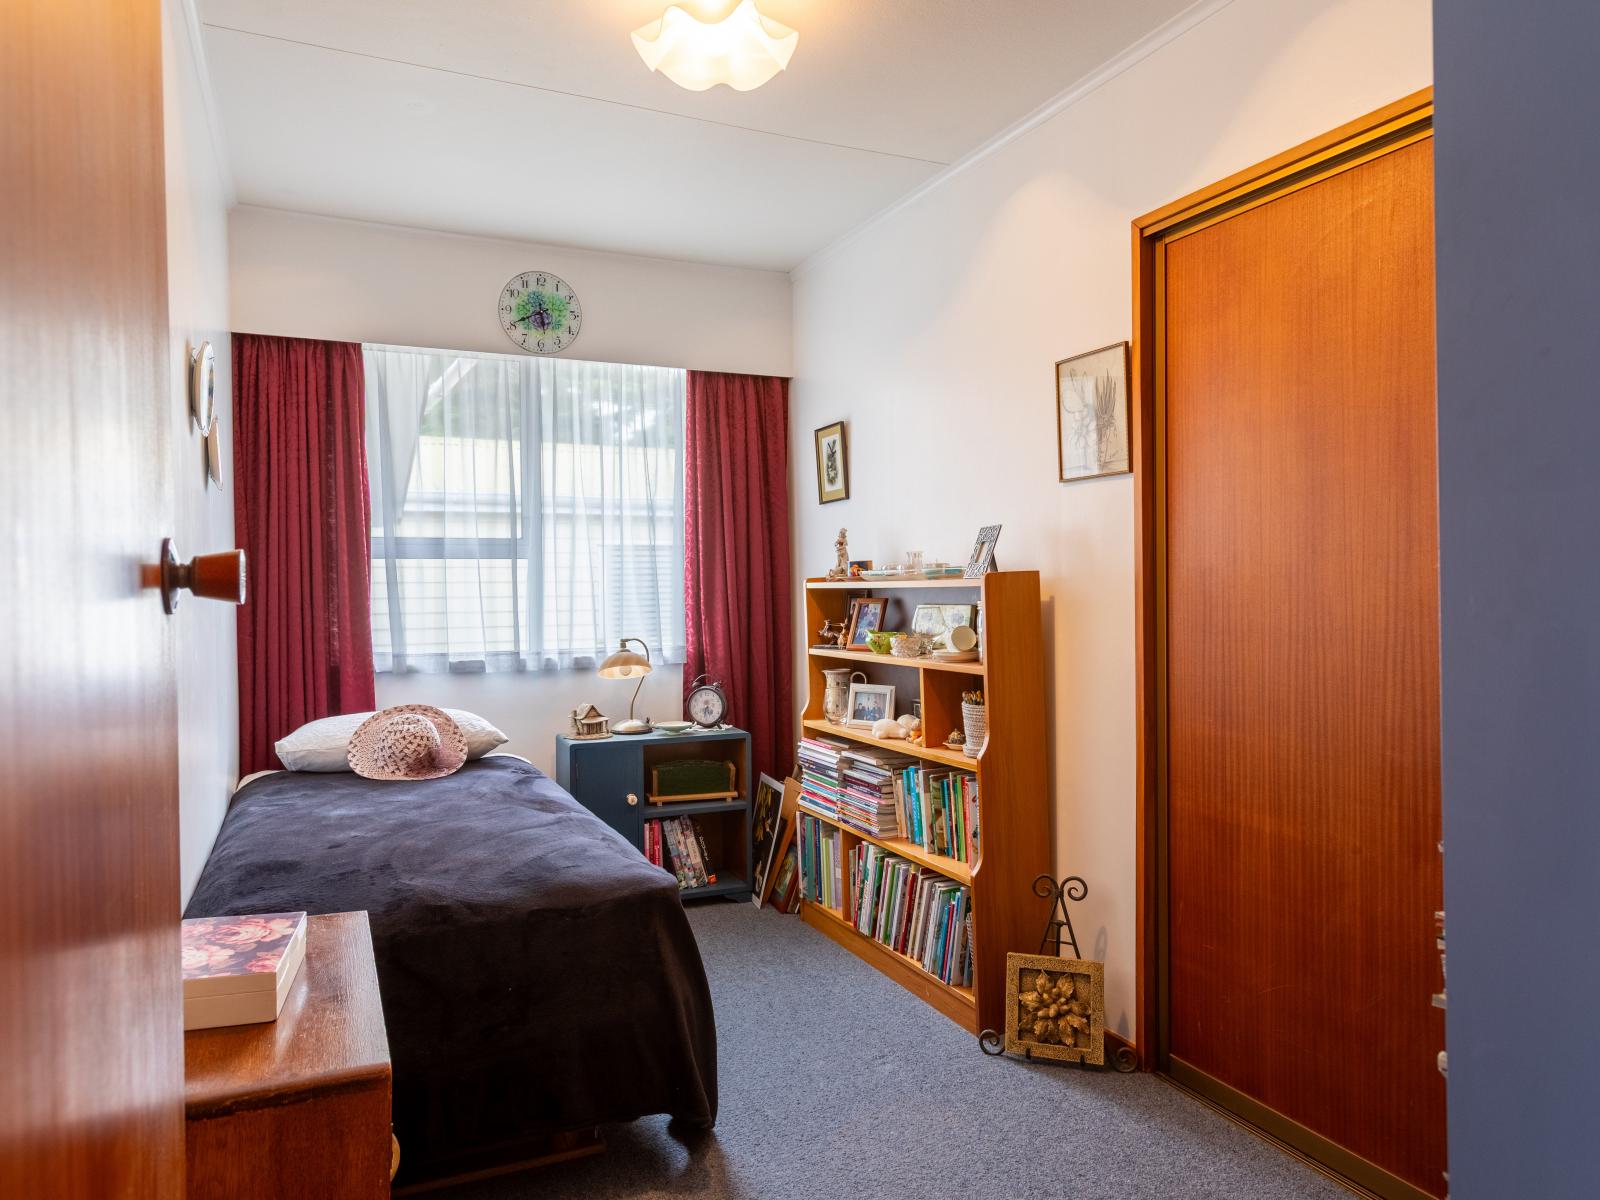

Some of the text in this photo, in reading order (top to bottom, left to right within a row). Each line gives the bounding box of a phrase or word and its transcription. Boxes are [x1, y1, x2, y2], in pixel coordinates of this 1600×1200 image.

[522, 279, 529, 288] 11
[536, 277, 546, 286] 12
[555, 283, 559, 292] 1
[510, 288, 520, 298] 10
[505, 305, 512, 314] 9
[510, 321, 517, 330] 8
[522, 333, 527, 343] 7
[553, 336, 561, 345] 5
[537, 339, 544, 349] 6
